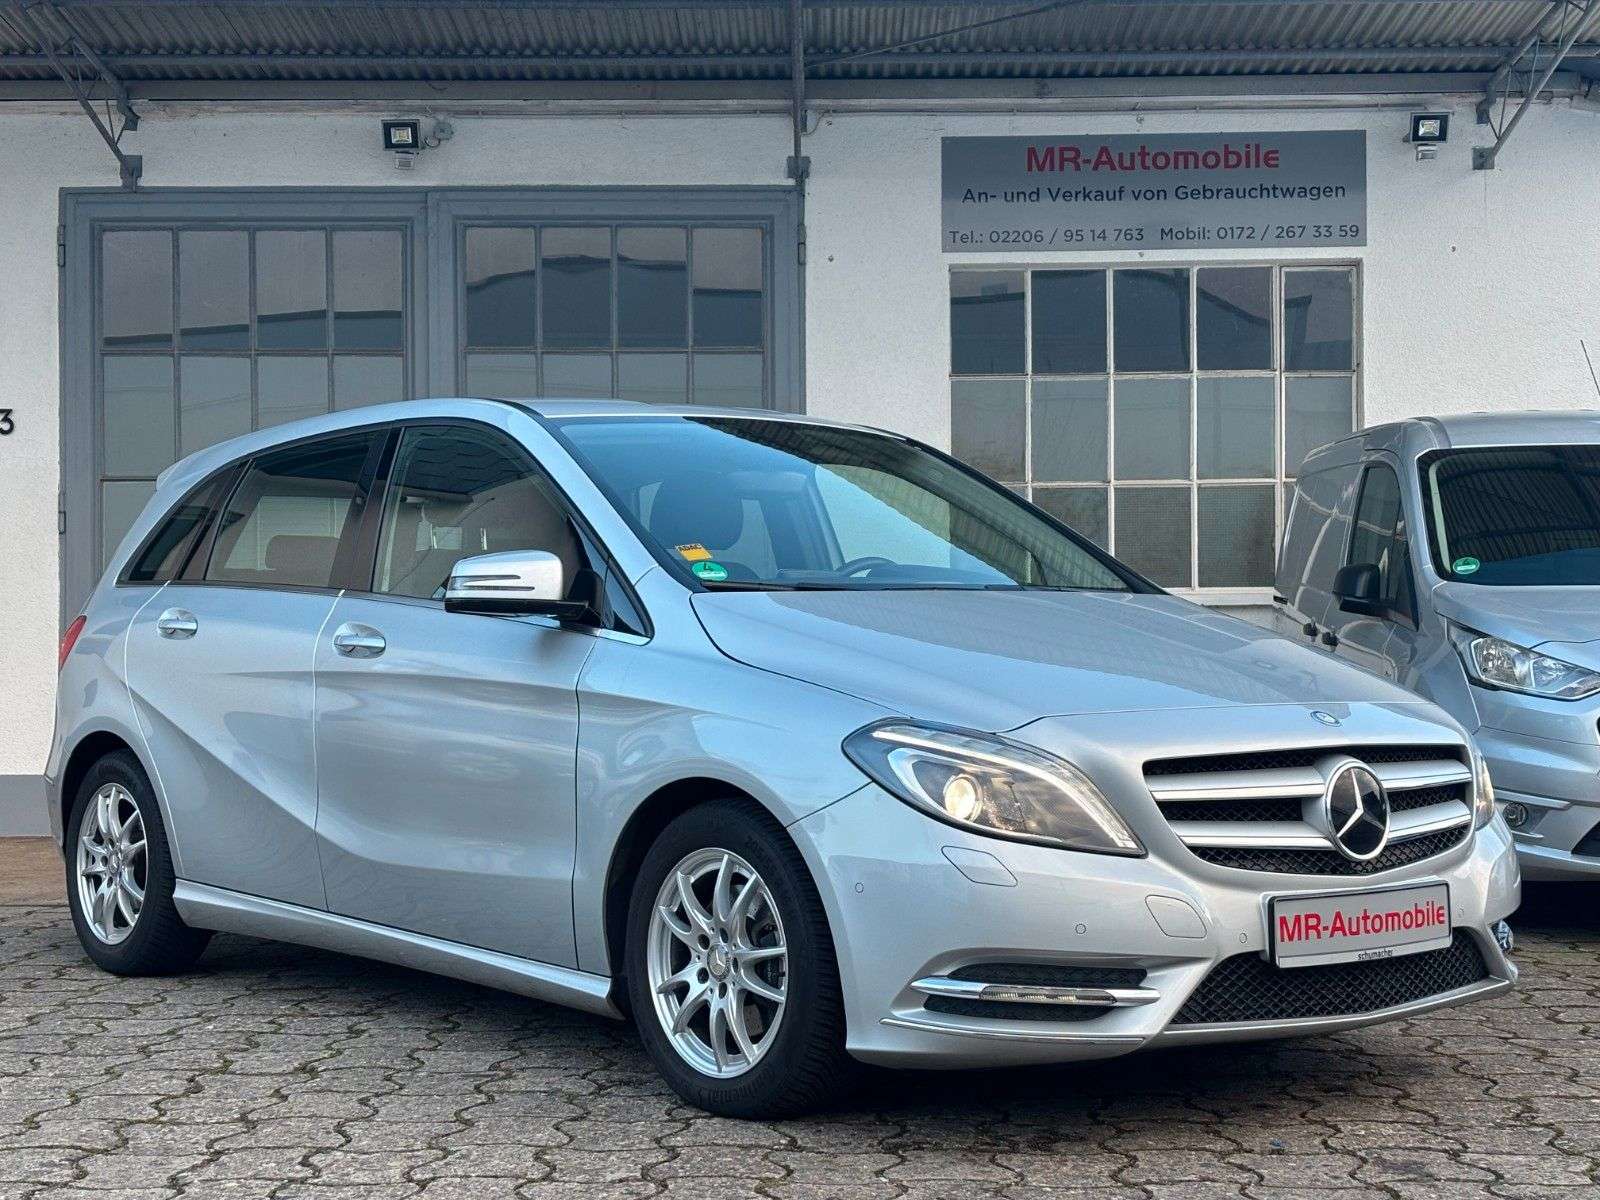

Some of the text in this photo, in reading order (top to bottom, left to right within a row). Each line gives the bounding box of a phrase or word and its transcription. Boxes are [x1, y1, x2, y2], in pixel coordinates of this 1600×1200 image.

[1026, 144, 1280, 172] MR-Automobile
[961, 183, 1346, 204] An- und Verkauf von Gebrauchtwagen
[949, 230, 983, 244] Tel.:
[989, 230, 1044, 243] 02206
[1063, 229, 1084, 242] 95
[1089, 229, 1107, 242] 14
[1113, 228, 1144, 242] 763
[1160, 226, 1211, 241] Mobil:
[1216, 226, 1256, 240] 0172
[1275, 225, 1306, 238] 267
[1312, 225, 1333, 238] 33
[1338, 224, 1360, 238] 59
[1279, 901, 1445, 942] MR-Automobile
